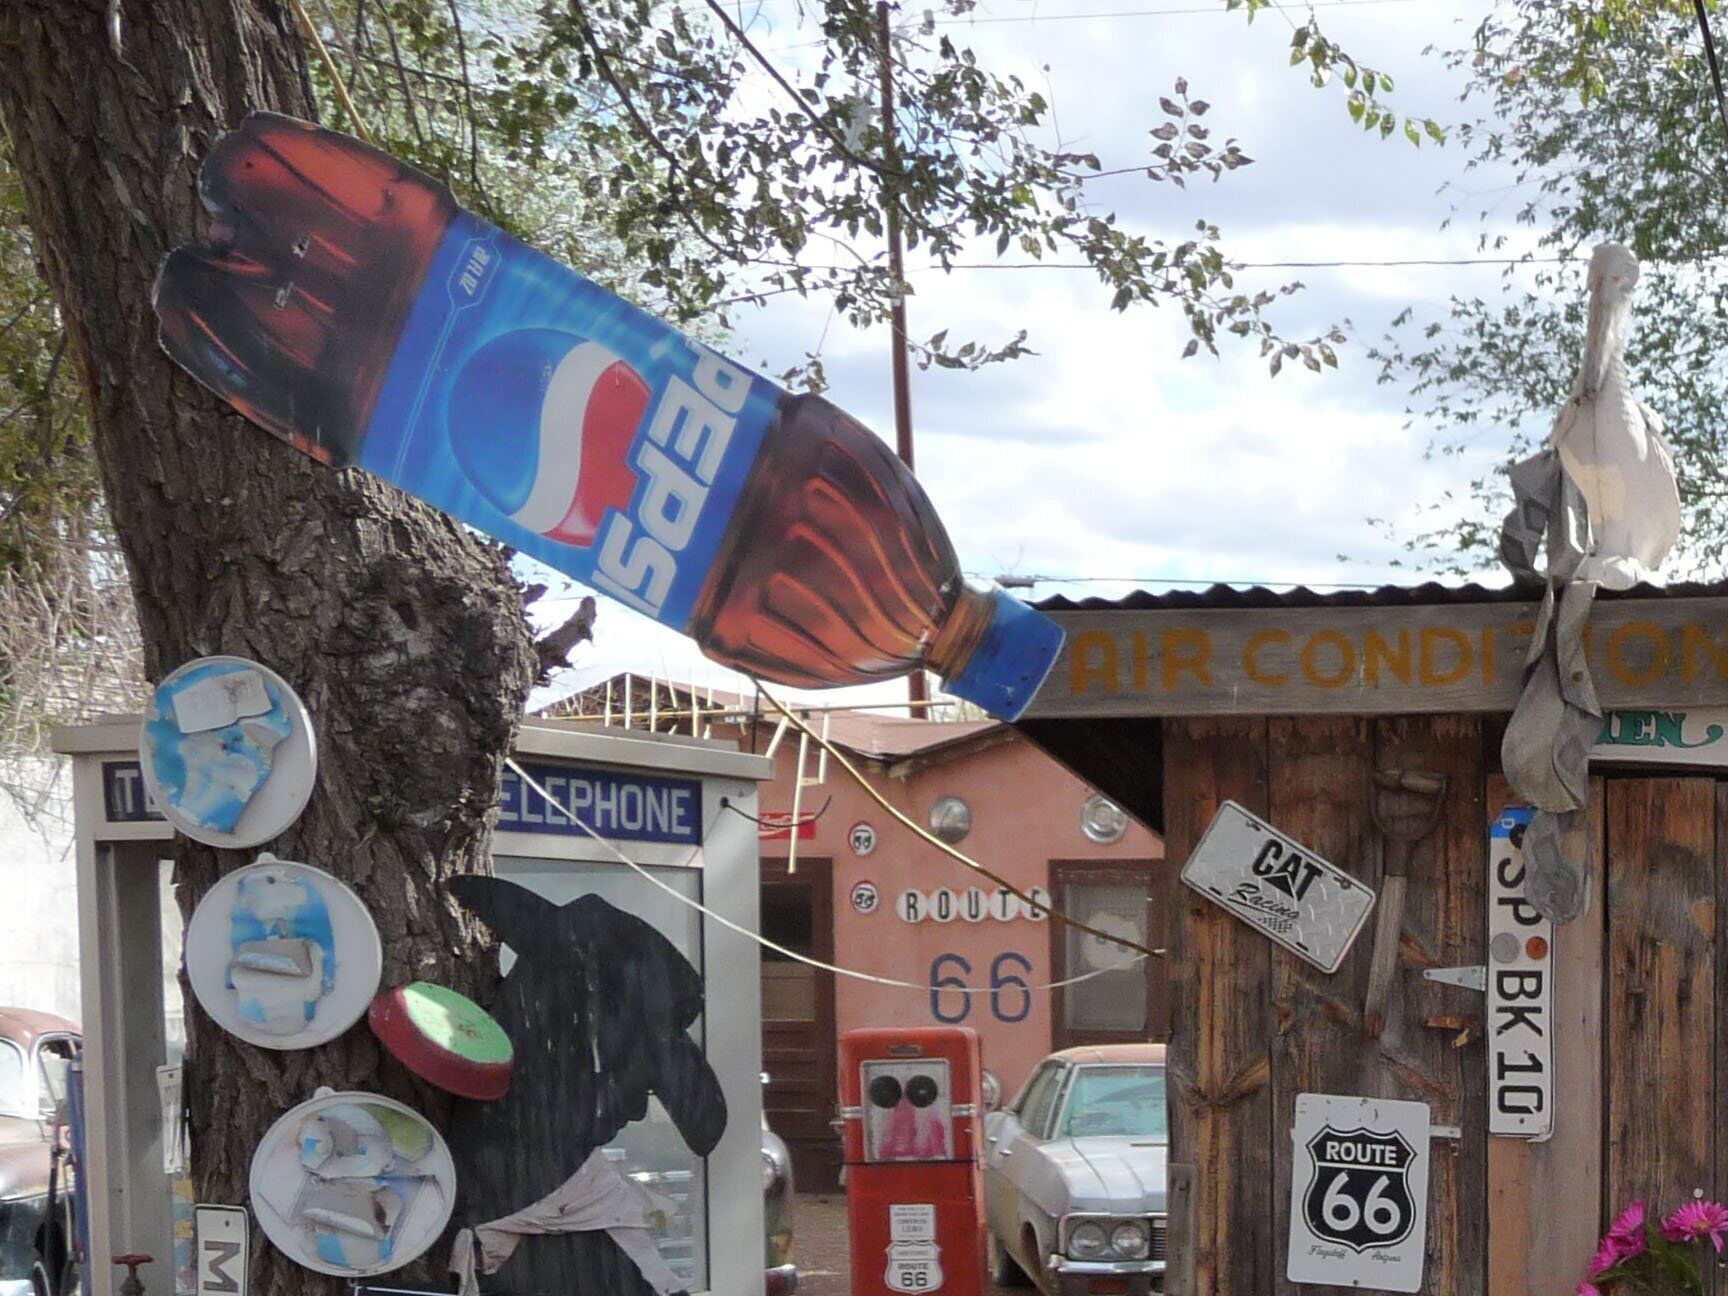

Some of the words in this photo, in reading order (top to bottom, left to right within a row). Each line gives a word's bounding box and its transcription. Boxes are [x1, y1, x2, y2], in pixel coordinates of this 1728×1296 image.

[591, 338, 754, 619] PEPSI
[1069, 627, 1216, 695] AIR
[498, 771, 692, 836] ELEPHONE
[1252, 828, 1325, 901] CAT
[904, 888, 1043, 922] ROUTE
[1231, 881, 1301, 924] Racing
[929, 951, 1033, 1024] 66
[1497, 969, 1543, 1038] BK
[1498, 1050, 1543, 1115] 10
[1325, 1140, 1399, 1166] ROUTE
[1321, 1170, 1402, 1236] 66
[900, 1271, 928, 1287] 66
